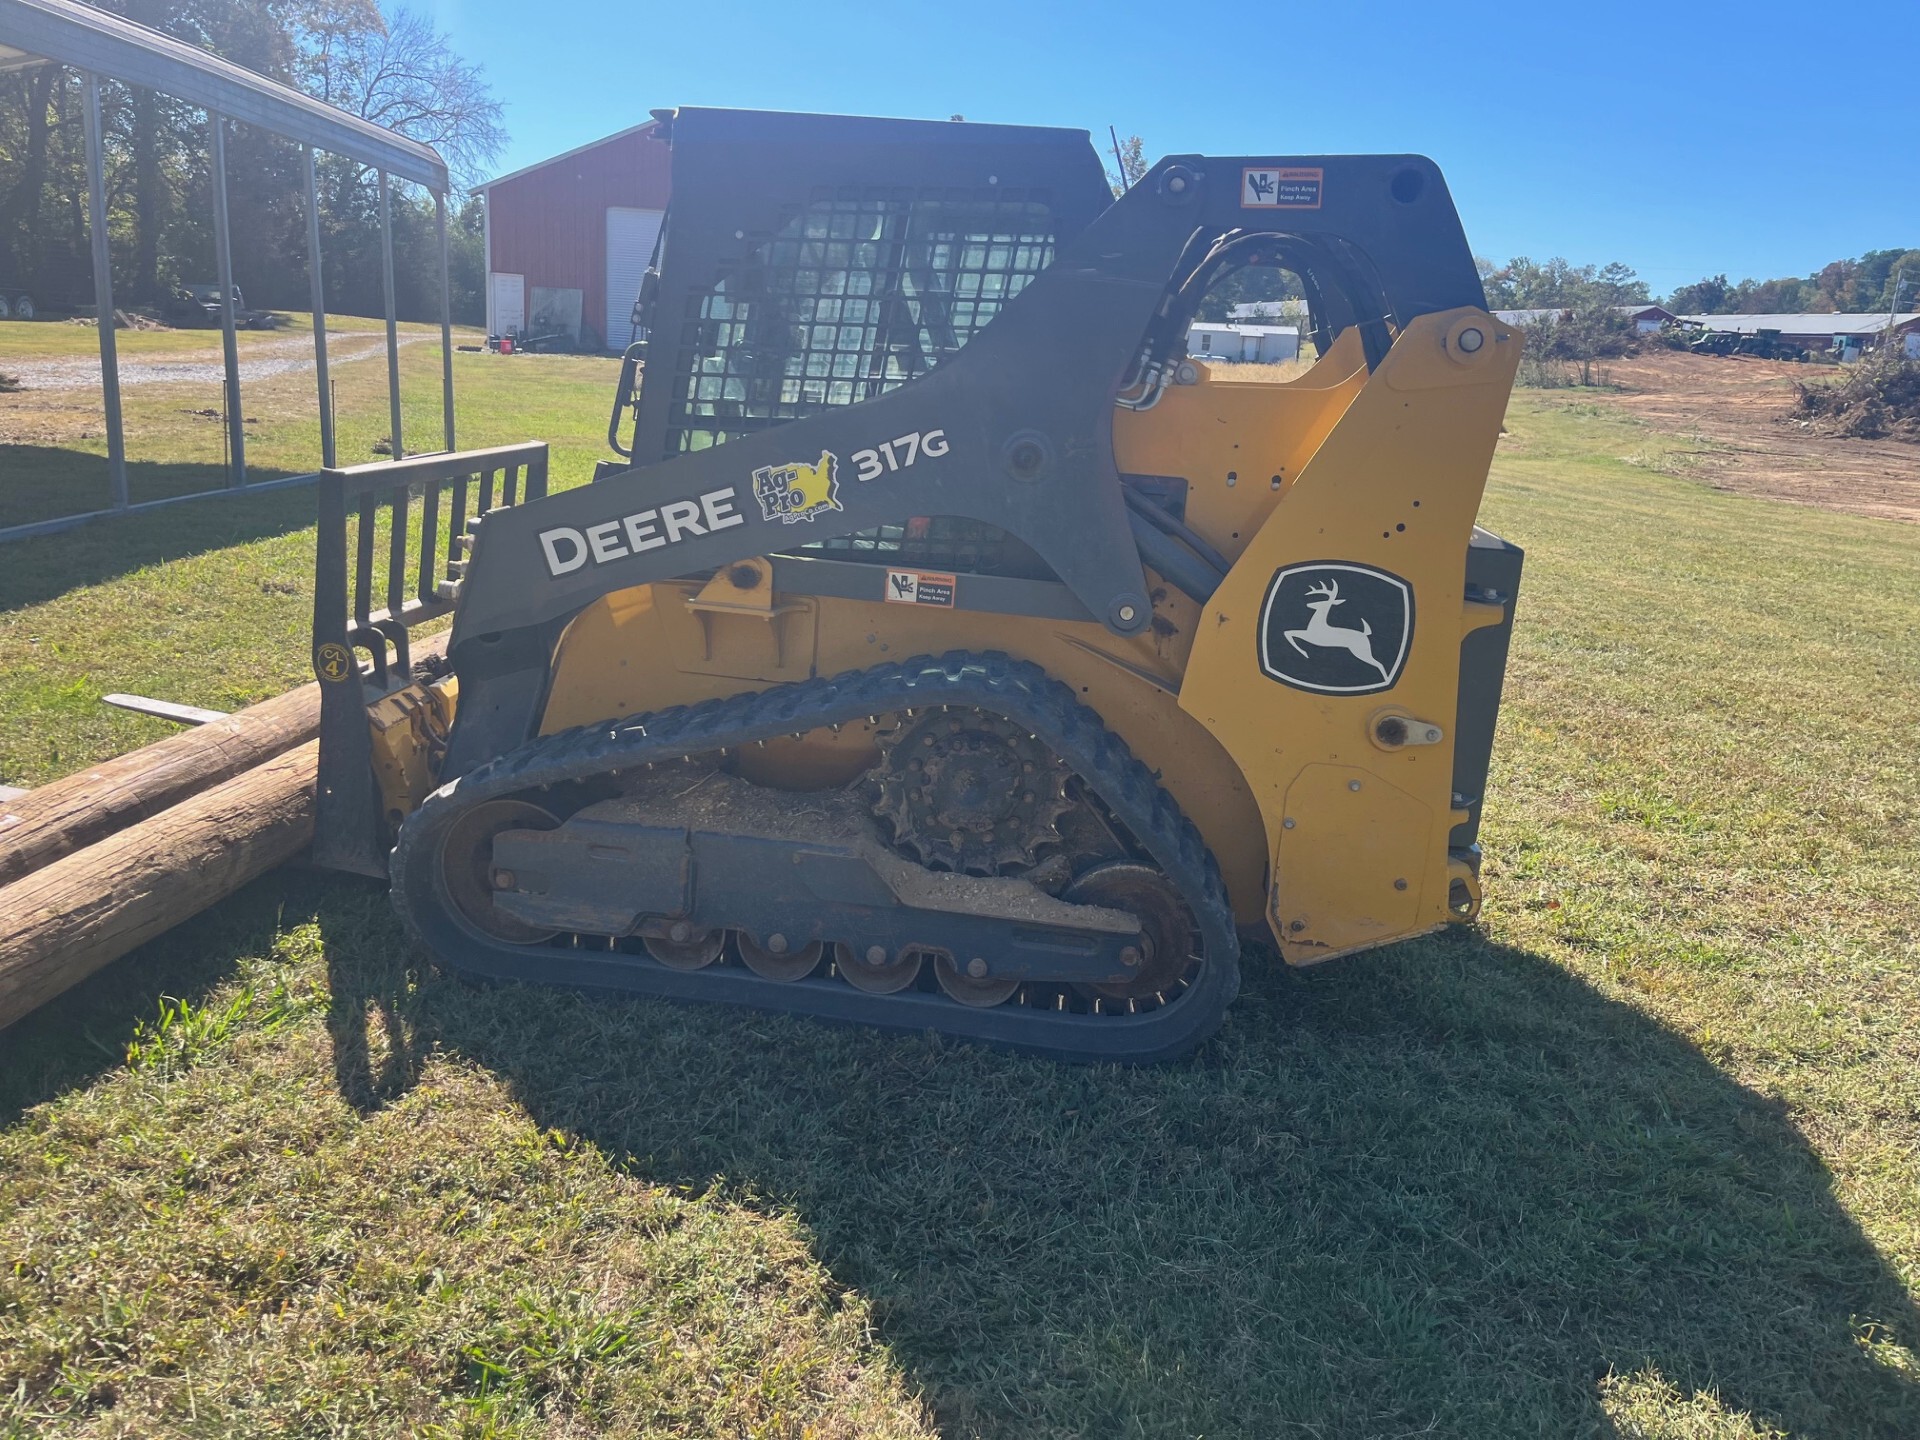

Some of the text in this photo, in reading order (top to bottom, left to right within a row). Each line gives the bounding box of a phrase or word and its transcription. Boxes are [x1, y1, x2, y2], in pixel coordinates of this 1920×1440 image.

[851, 429, 950, 482] 317G
[760, 488, 805, 519] Pro
[539, 486, 744, 576] DEERE
[919, 586, 936, 594] Pinch
[325, 660, 339, 676] 4
